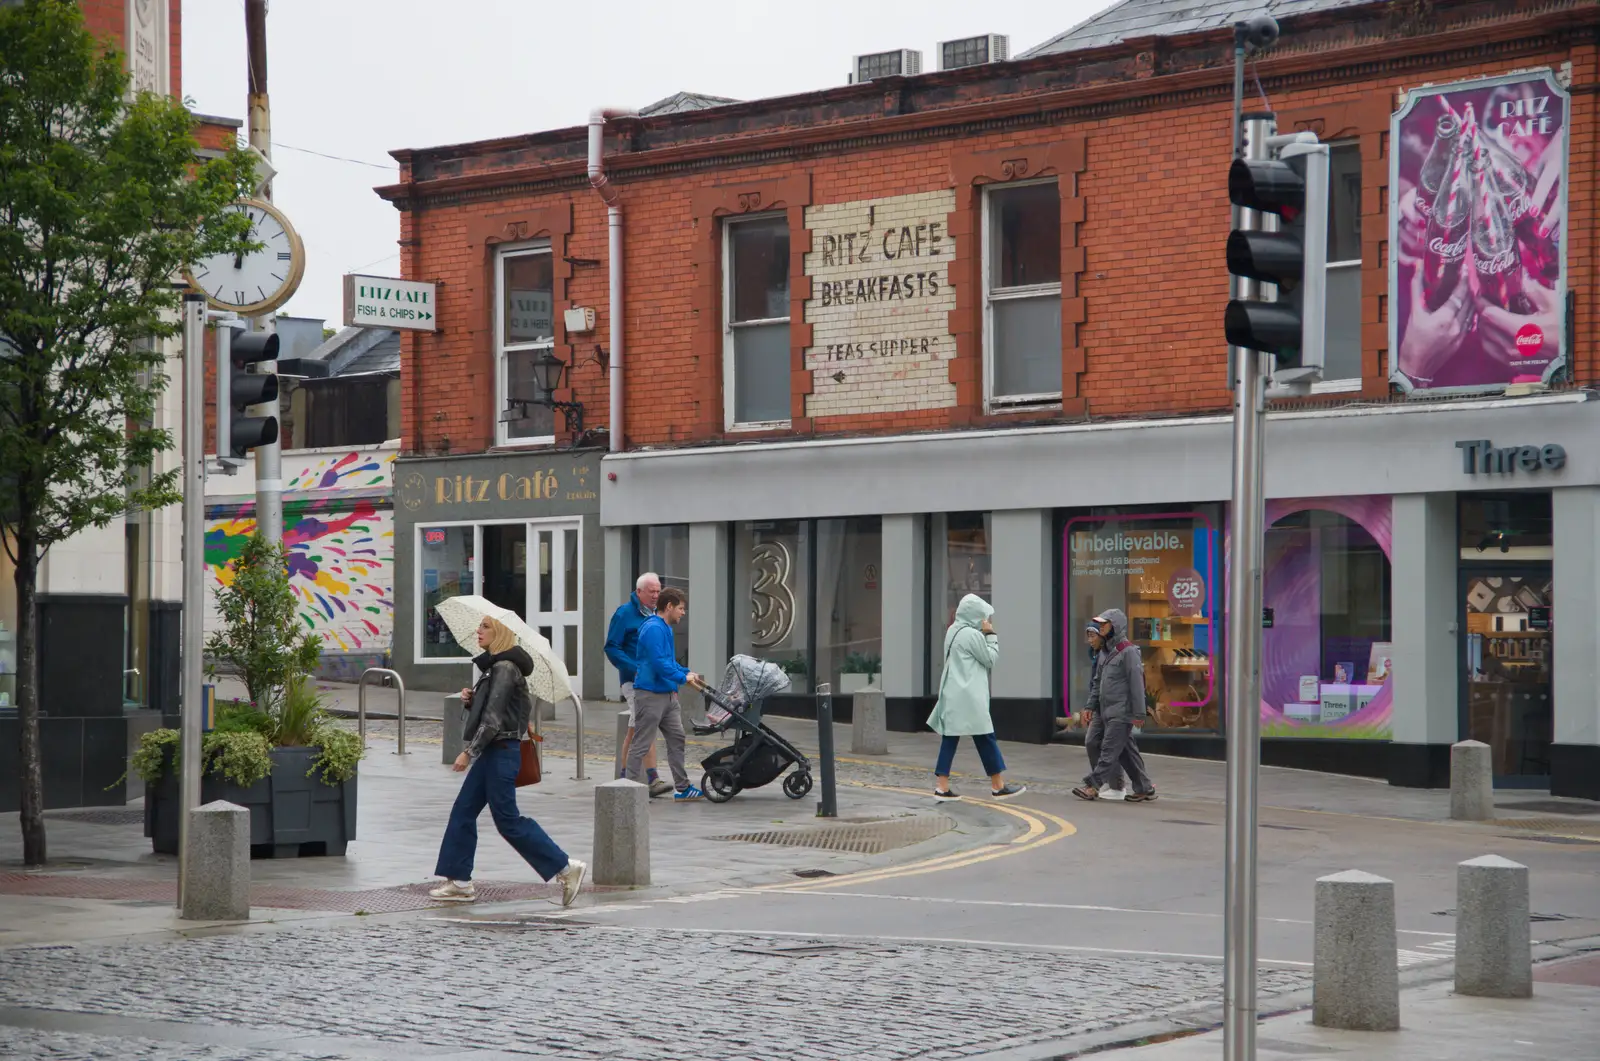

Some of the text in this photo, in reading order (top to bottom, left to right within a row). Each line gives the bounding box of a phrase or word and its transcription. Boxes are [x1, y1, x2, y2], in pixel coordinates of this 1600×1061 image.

[1500, 96, 1549, 118] RITZ
[1498, 117, 1552, 138] CAFE
[822, 222, 942, 267] RITZ CAFE
[360, 285, 431, 305] RITZ CAFE
[822, 271, 939, 307] BREAKFASTS
[357, 304, 415, 320] FISH & CHIPS
[826, 343, 864, 362] TEAS
[1455, 439, 1567, 474] Three
[434, 474, 491, 504] Ritz
[496, 468, 559, 501] Café
[1071, 532, 1184, 552] Unbelievable.
[1172, 582, 1200, 599] €25
[1323, 701, 1347, 710] Three+
